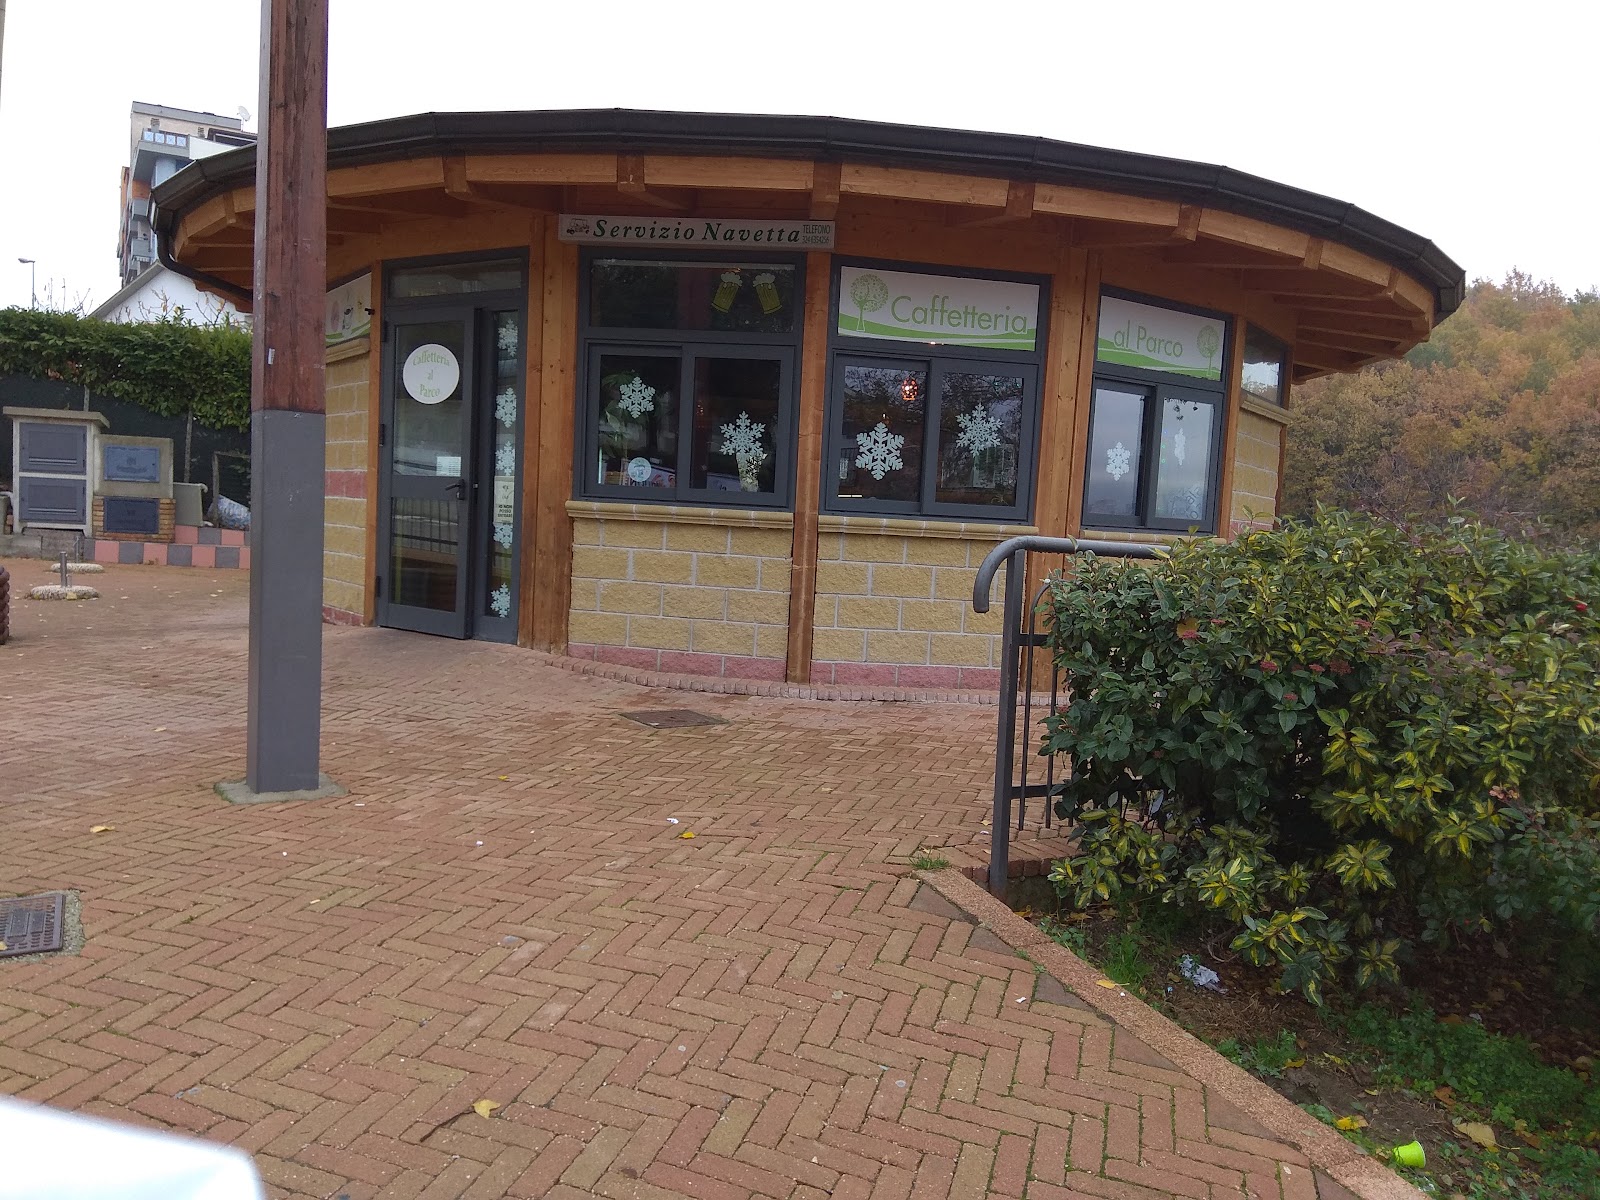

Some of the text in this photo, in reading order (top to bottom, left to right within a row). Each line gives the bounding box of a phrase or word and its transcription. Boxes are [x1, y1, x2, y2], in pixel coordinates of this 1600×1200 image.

[593, 219, 800, 243] Servizio Navetta
[803, 224, 831, 234] TELEFONO
[891, 294, 1028, 334] Caffetteria
[1114, 320, 1183, 358] al Parco
[412, 349, 450, 366] Caffetteria
[425, 369, 434, 380] al
[420, 383, 441, 398] Parco
